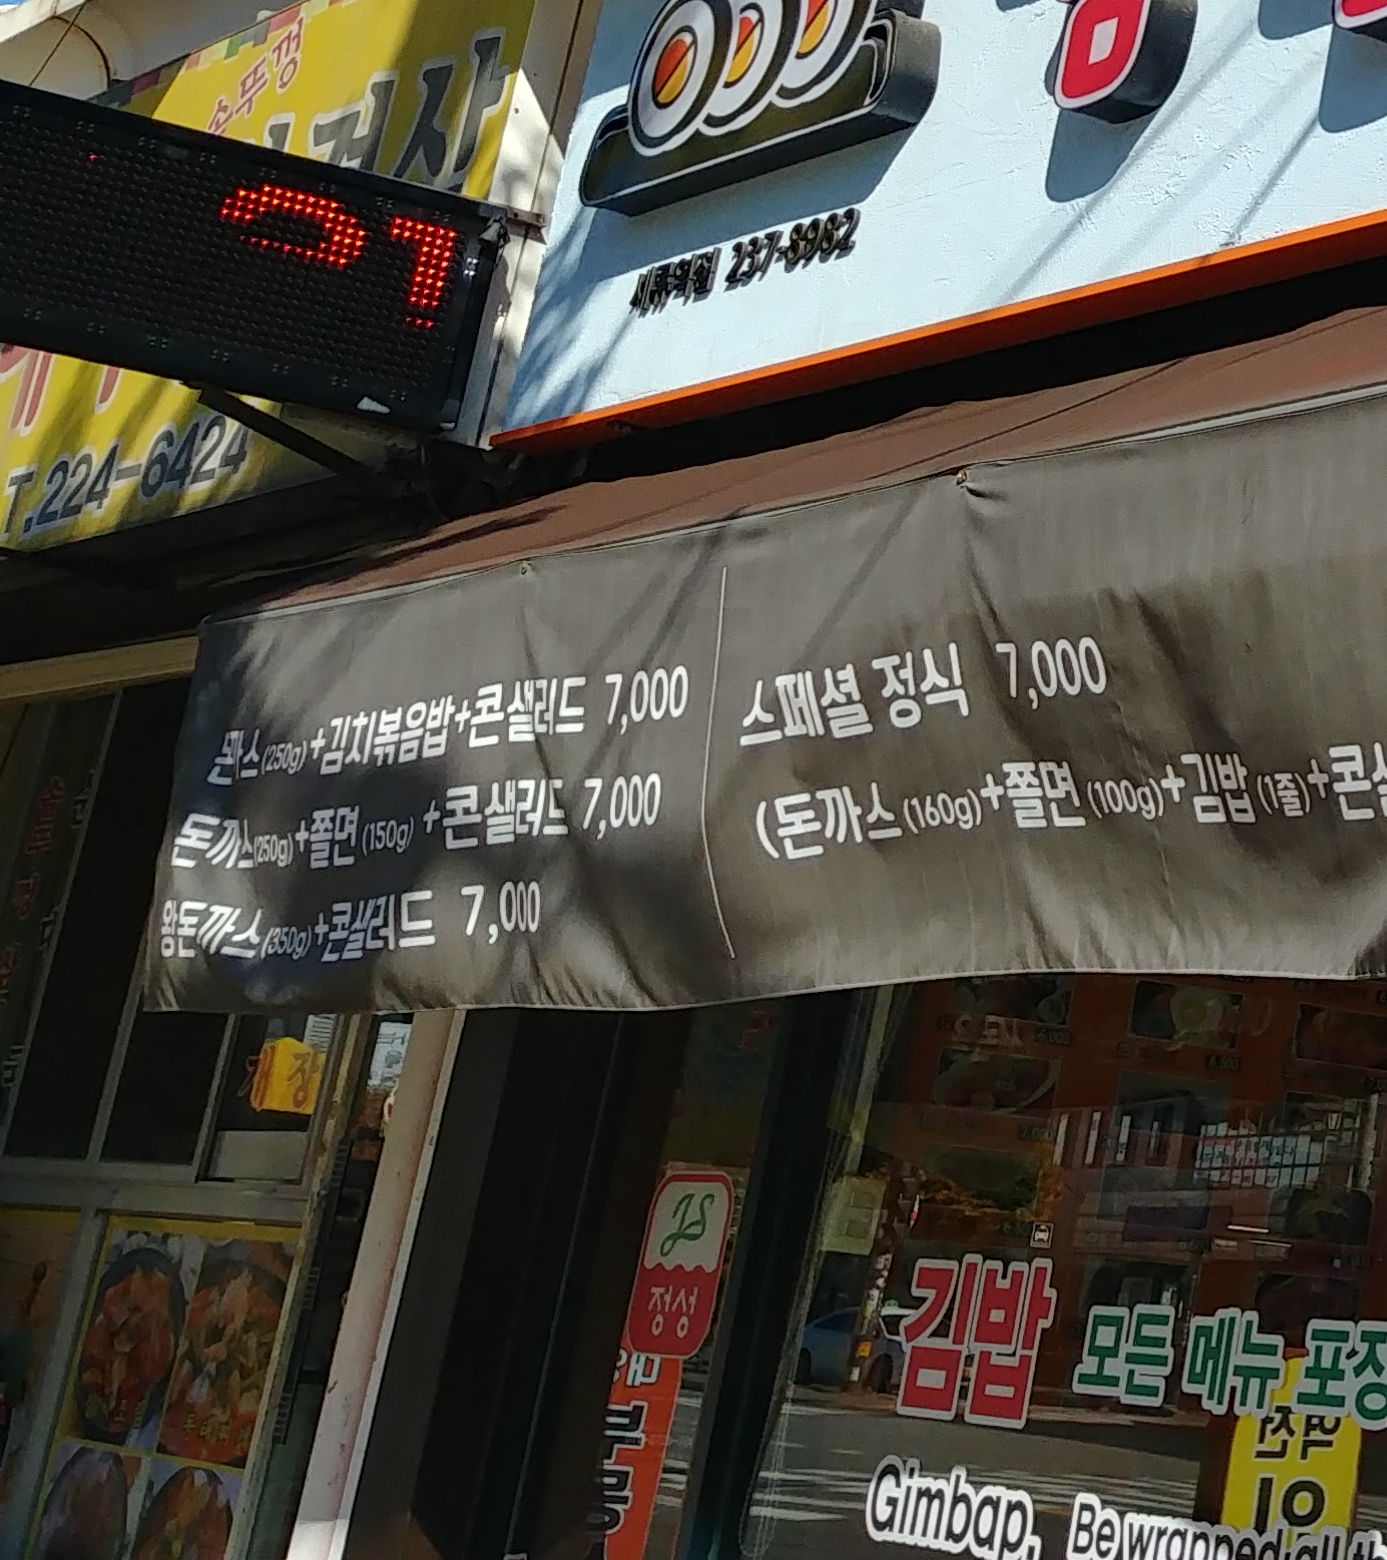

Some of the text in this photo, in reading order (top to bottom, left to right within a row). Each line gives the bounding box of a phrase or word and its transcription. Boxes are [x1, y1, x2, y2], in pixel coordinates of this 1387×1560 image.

[724, 206, 862, 285] 237-8982
[2, 413, 251, 535] T.224-6424
[604, 664, 691, 734] 7,000
[738, 634, 1109, 748] 스페셜 정식 7,000
[580, 771, 663, 841] 7,000
[460, 880, 543, 947] 7,000
[647, 1284, 698, 1339] 정성
[896, 1253, 1057, 1430] 김밥
[1072, 1303, 1177, 1407] 모든
[1180, 1307, 1286, 1419] 메뉴
[1070, 1501, 1117, 1560] Be
